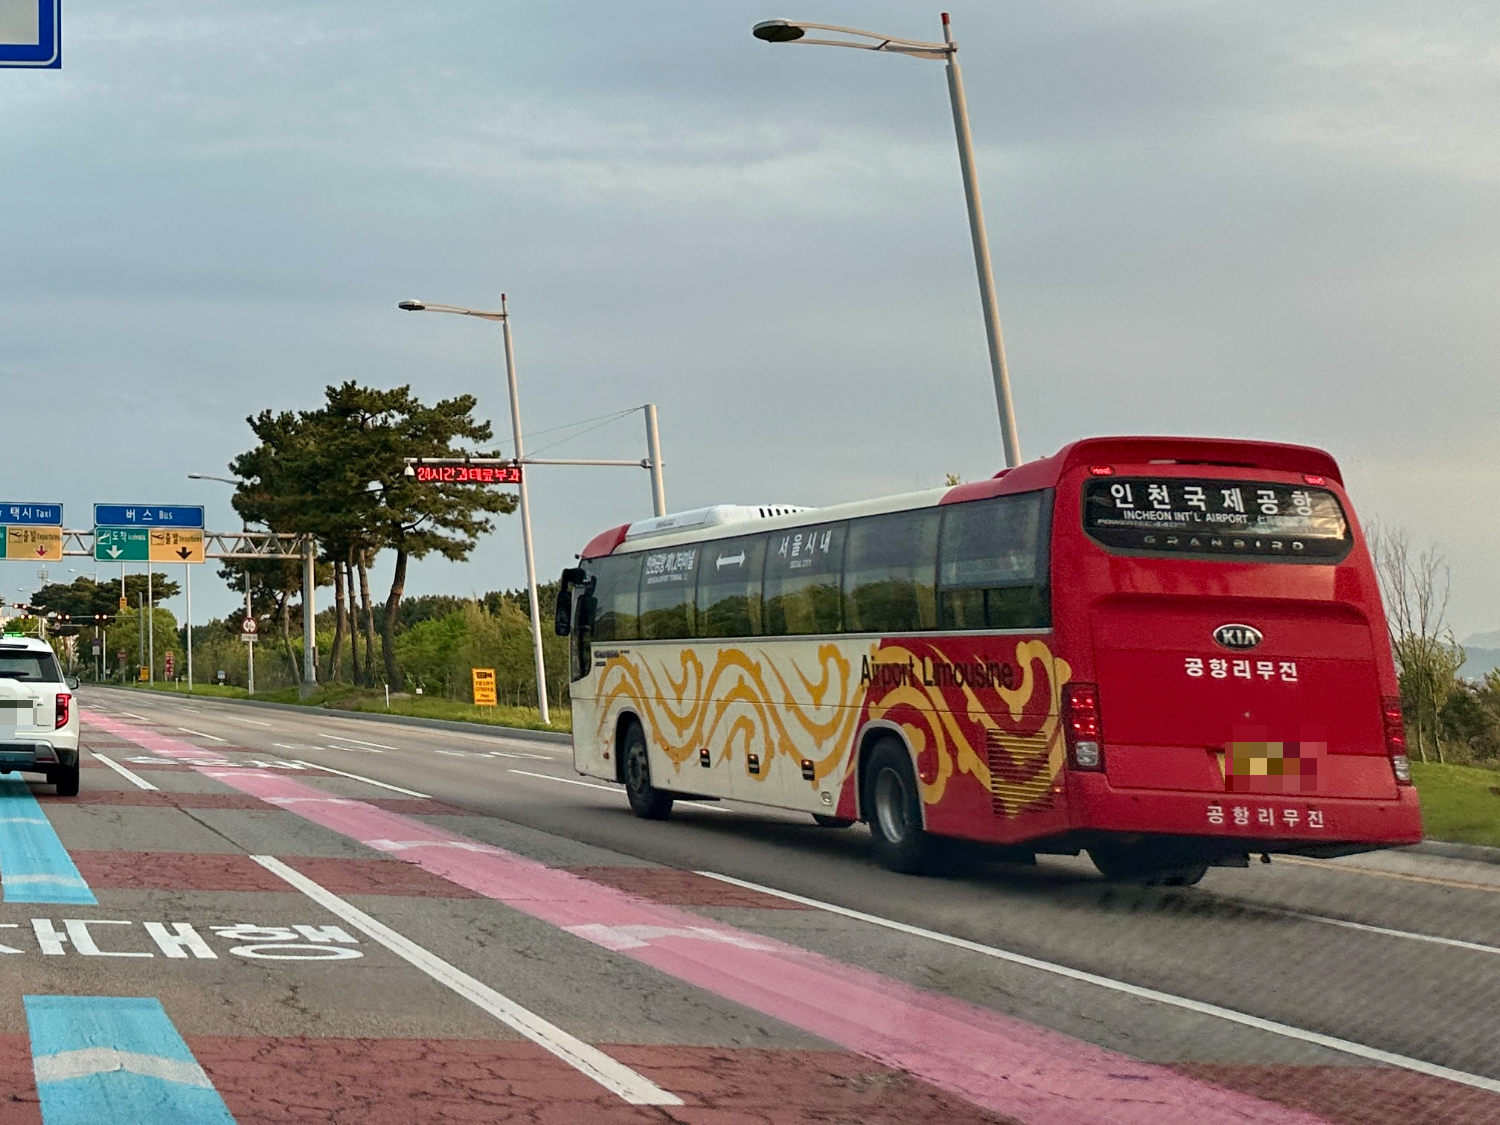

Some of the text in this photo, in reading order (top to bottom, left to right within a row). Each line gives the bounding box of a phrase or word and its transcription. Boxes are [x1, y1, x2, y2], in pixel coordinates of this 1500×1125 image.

[1110, 483, 1313, 517] 인천국제공항
[10, 506, 32, 521] 택시
[36, 509, 52, 518] Taxi
[125, 508, 173, 522] 버스 Bus
[1123, 510, 1172, 522] INCHEON
[1174, 511, 1201, 523] INT'L
[1205, 512, 1248, 525] AIRPORT
[1221, 628, 1255, 646] KIA
[860, 654, 1015, 690] Airport Limousine
[1184, 657, 1299, 683] 공항리무진
[1206, 805, 1325, 829] 공항리무진
